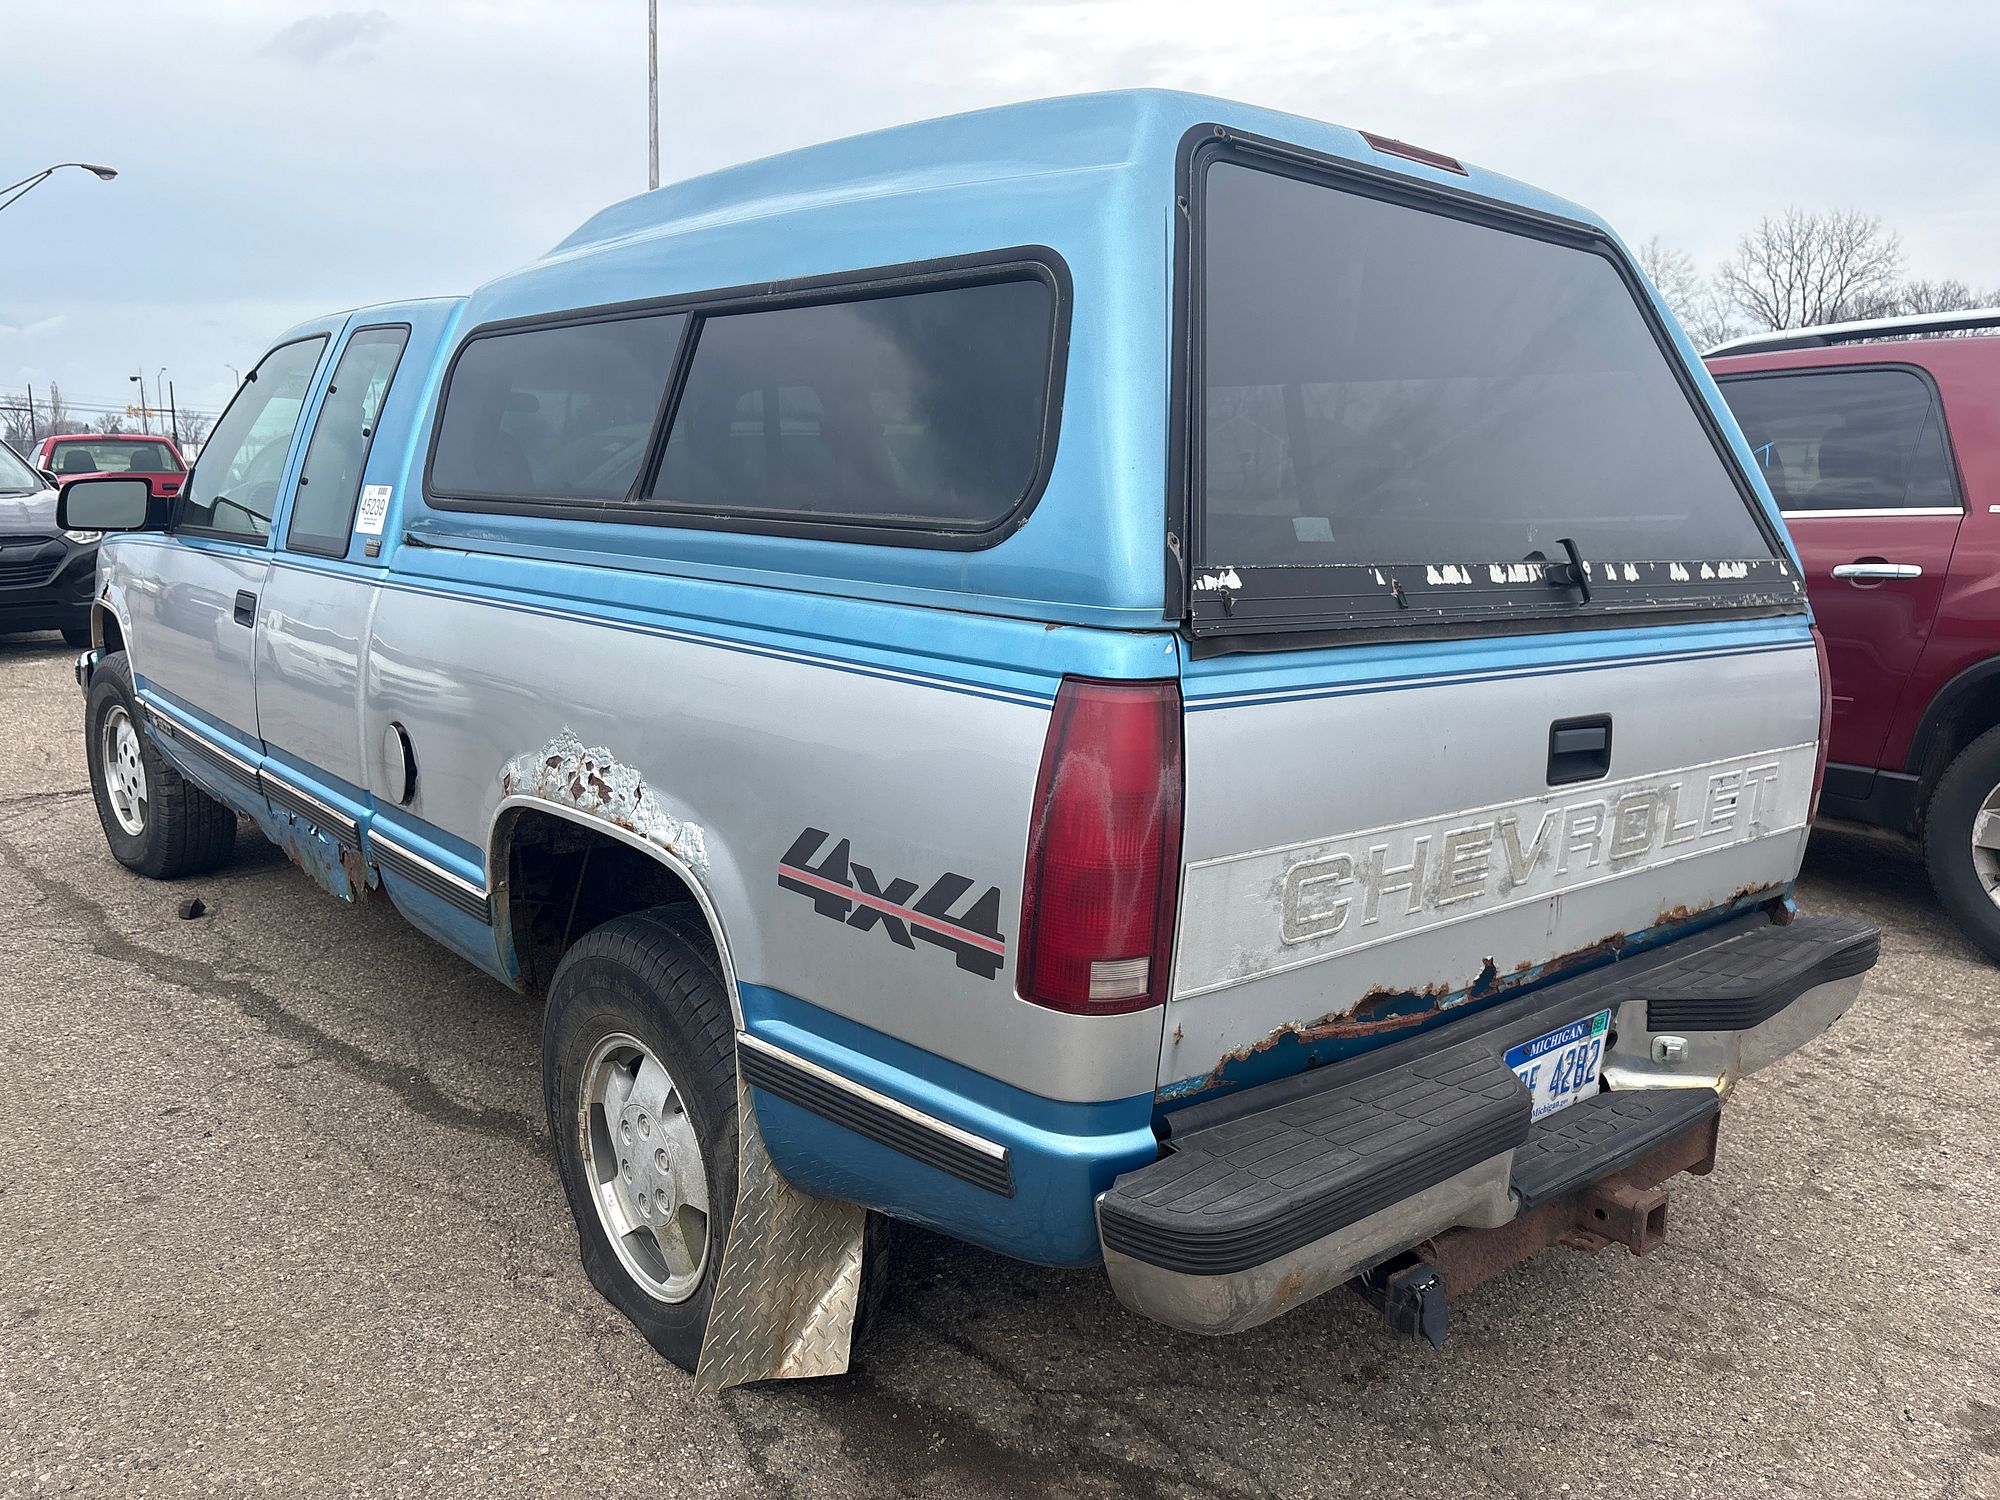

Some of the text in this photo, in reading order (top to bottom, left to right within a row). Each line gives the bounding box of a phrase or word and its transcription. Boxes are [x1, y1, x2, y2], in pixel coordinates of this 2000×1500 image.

[361, 498, 385, 516] 45239
[1278, 760, 1780, 945] CHEVROLET
[1530, 1024, 1584, 1057] MICHIGAN
[1549, 1039, 1600, 1097] 4282
